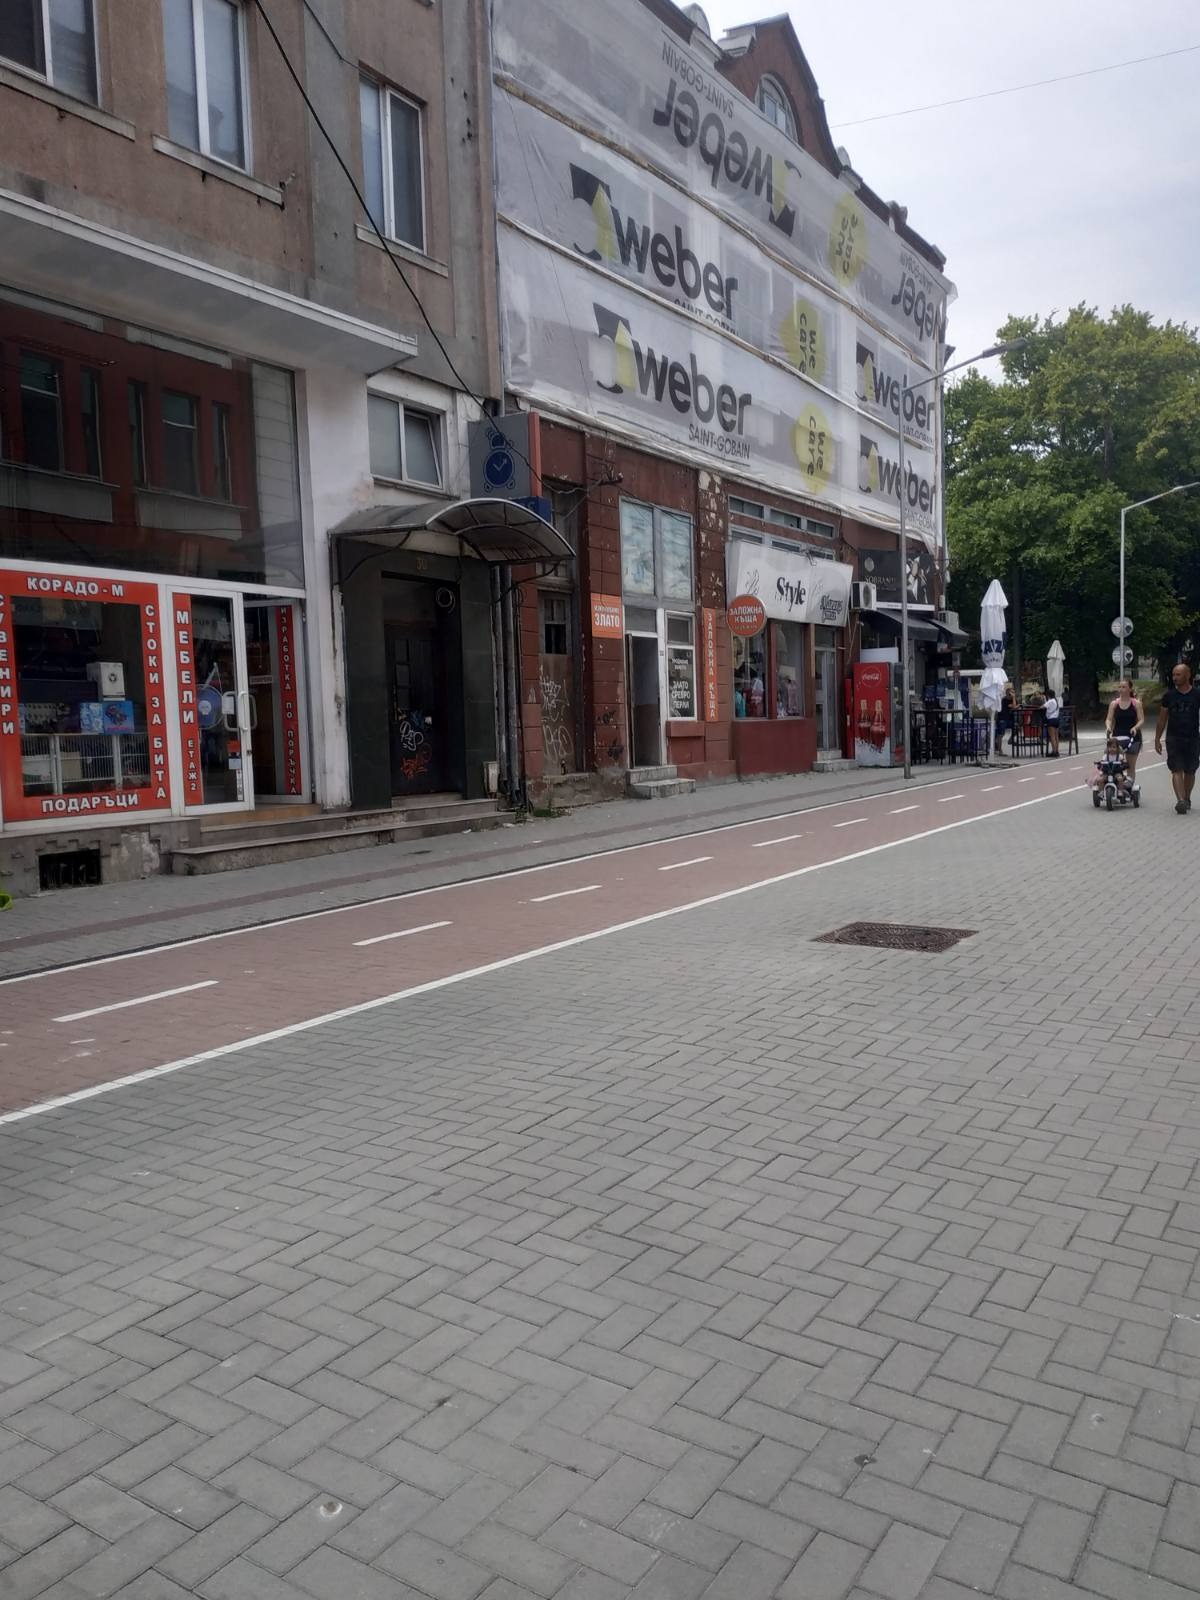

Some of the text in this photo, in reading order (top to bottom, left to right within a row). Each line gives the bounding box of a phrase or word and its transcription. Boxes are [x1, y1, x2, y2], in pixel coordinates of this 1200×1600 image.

[662, 41, 734, 119] SAINT-GOBAIN
[653, 77, 773, 204] weber
[610, 205, 738, 320] weber
[631, 339, 752, 435] weber
[872, 366, 936, 430] weber
[688, 424, 750, 460] SAINT-GOBAIN
[807, 415, 816, 476] care
[818, 431, 826, 472] we
[595, 612, 620, 628] ЗЛАТО
[729, 606, 763, 616] ЗАЛОЖНА
[734, 615, 757, 623] КЪЩА
[776, 576, 806, 612] Style
[177, 610, 194, 724] МЕБЕЛИ
[280, 607, 292, 690] ИЗРАБОТКА
[286, 702, 293, 719] ПО
[145, 604, 166, 799] СТОКИ ЗА БИТА
[42, 793, 138, 812] ПОДАРЪЦИ
